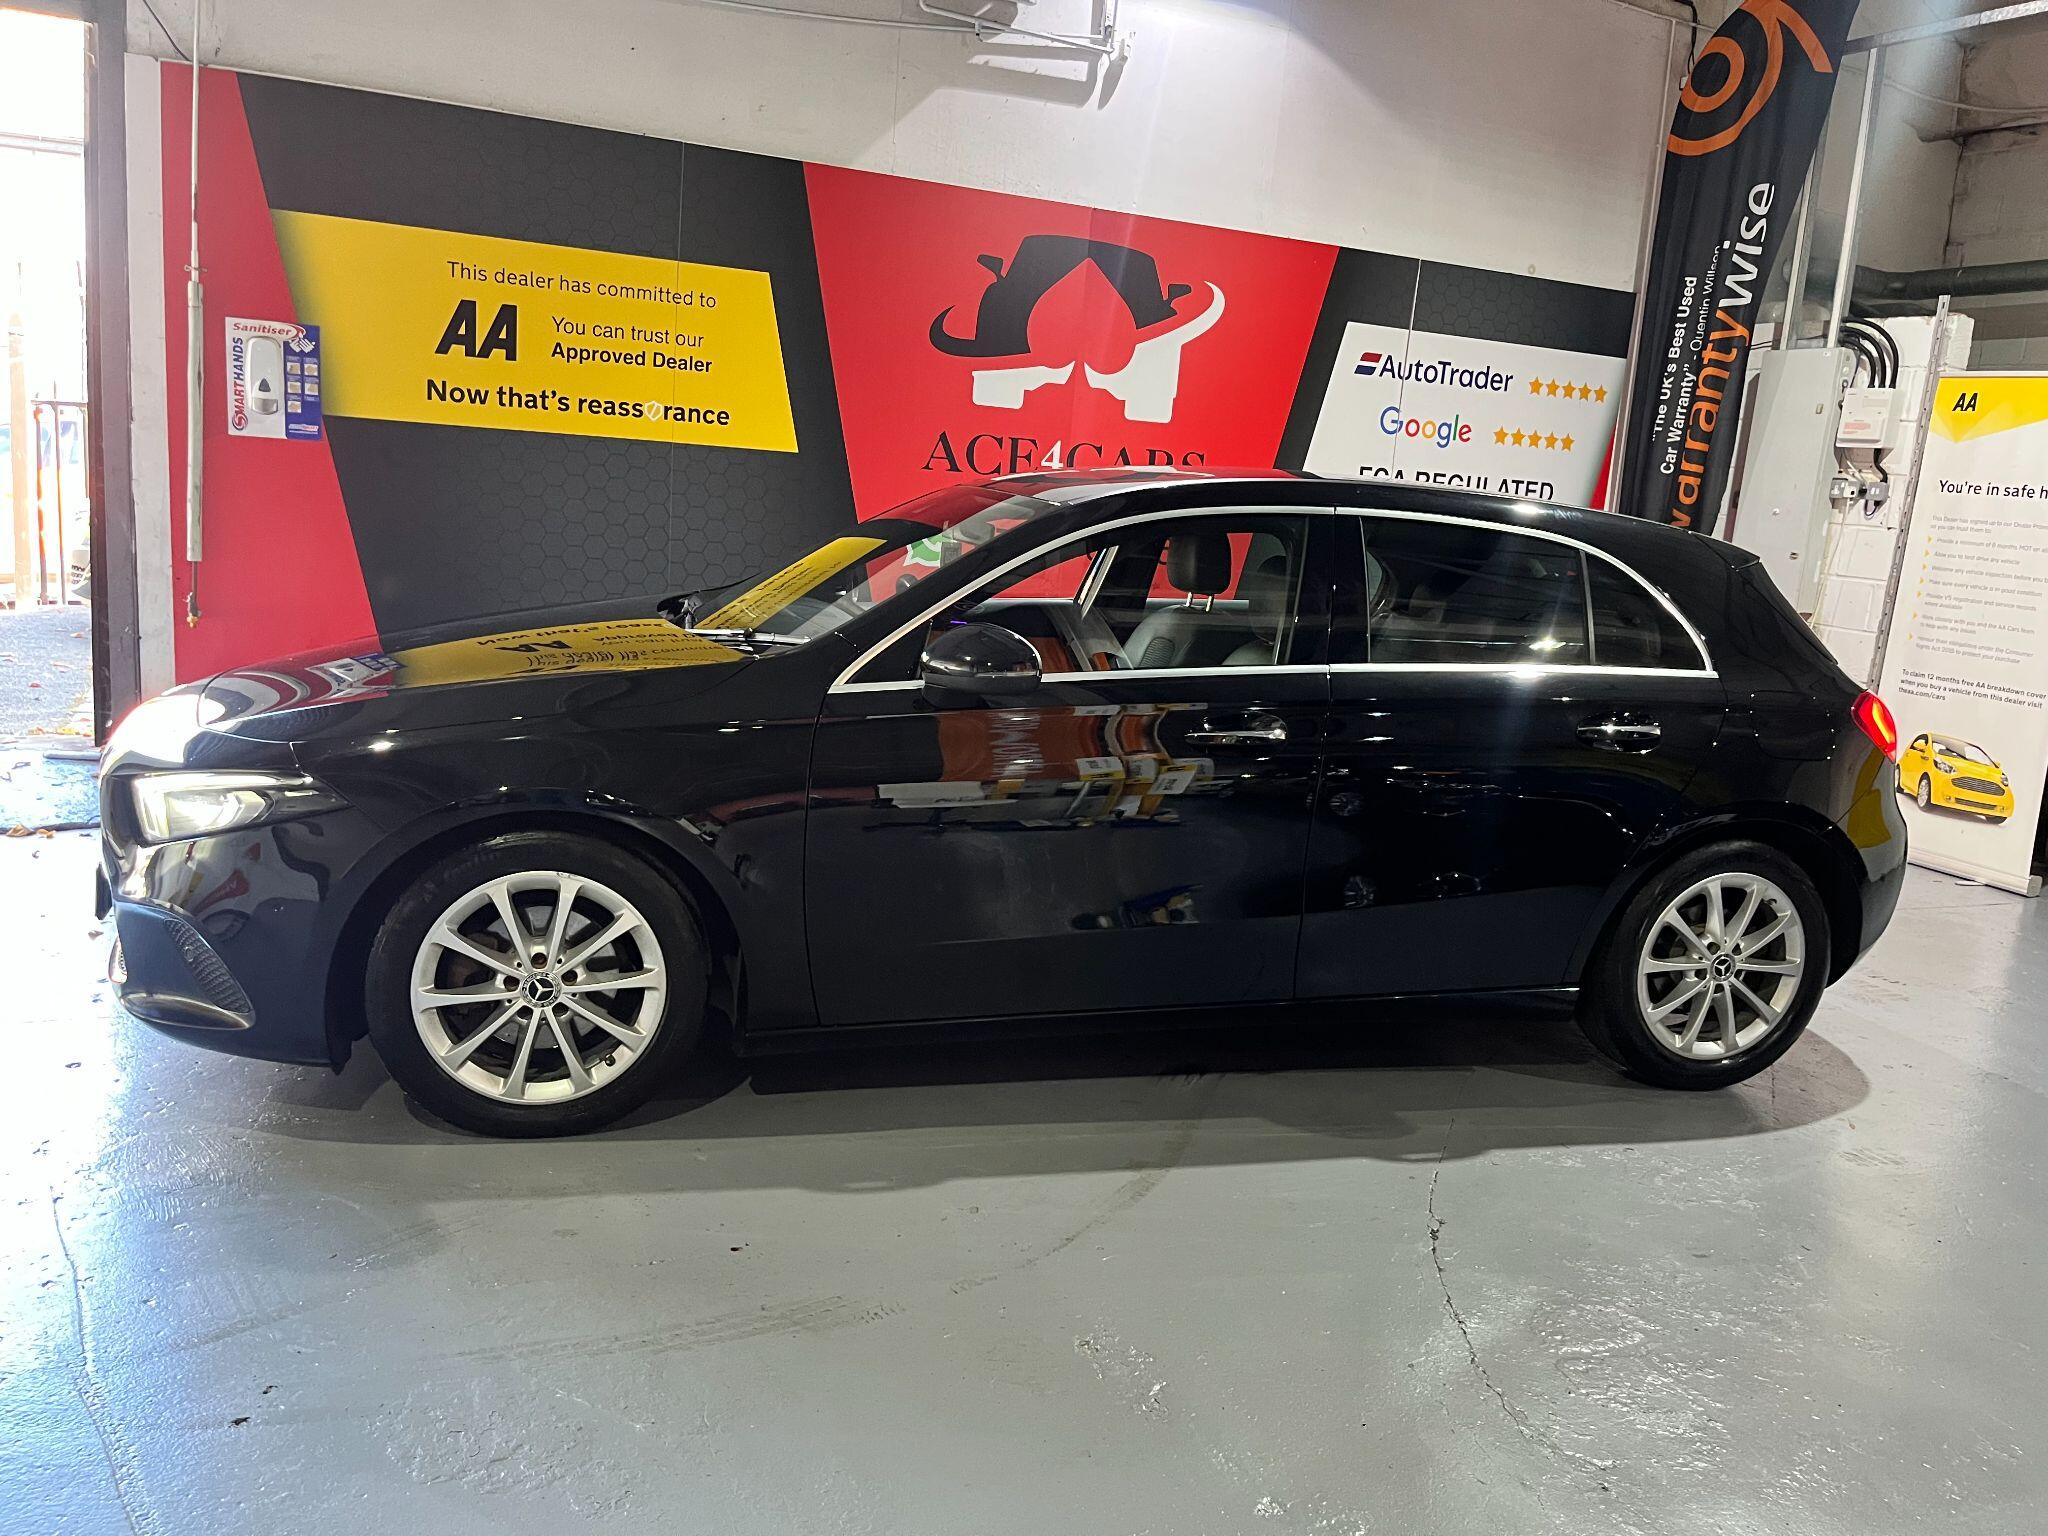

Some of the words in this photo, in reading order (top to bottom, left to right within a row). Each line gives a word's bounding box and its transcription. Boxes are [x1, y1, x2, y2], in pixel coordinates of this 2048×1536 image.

[446, 260, 488, 282] This
[494, 267, 555, 289] dealer
[560, 274, 591, 294] has
[597, 283, 694, 306] committed
[699, 292, 717, 309] to
[1676, 276, 1698, 318] Used
[233, 322, 292, 336] Sanitiser
[434, 298, 518, 361] AA
[551, 315, 586, 336] You
[592, 323, 625, 340] can
[631, 325, 670, 345] trust
[675, 333, 704, 348] our
[1668, 322, 1687, 359] Best
[551, 341, 647, 367] Approved
[652, 351, 713, 373] Dealer
[1378, 354, 1514, 393] AutoTrader
[426, 378, 489, 405] Now
[1660, 446, 1678, 475] Car
[1690, 298, 1711, 351] Quentin
[1951, 392, 1979, 412] AA
[1379, 405, 1473, 449] Google
[1939, 479, 1982, 495] You're
[1986, 482, 2000, 496] in
[2003, 484, 2036, 499] safe
[1916, 681, 1929, 690] you
[1929, 683, 1942, 692] buy
[1947, 686, 1972, 697] vehicle
[1972, 690, 1989, 699] from
[1990, 692, 2003, 702] this
[2003, 696, 2027, 707] dealer
[2027, 701, 2043, 710] visit
[1935, 675, 1961, 685] months
[1961, 678, 1975, 687] free
[1975, 681, 1986, 689] AA
[1986, 683, 2025, 697] breakdown
[2026, 690, 2047, 700] cover
